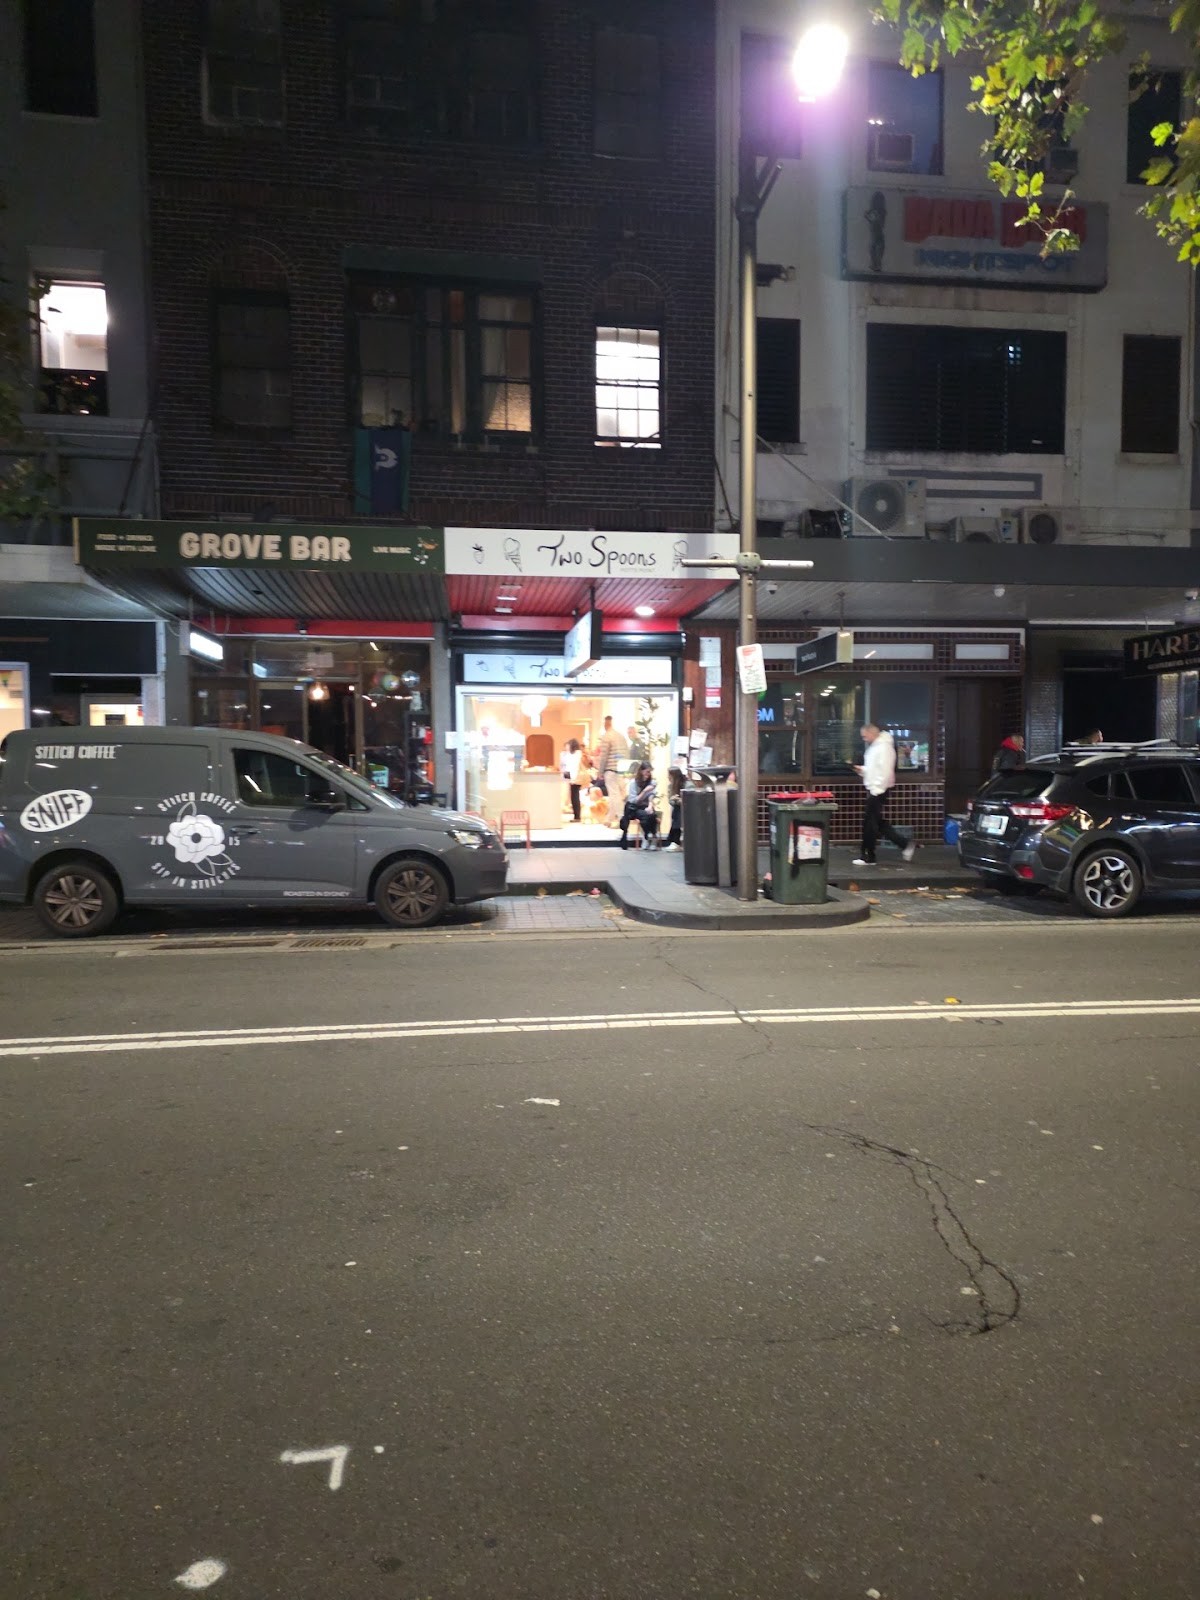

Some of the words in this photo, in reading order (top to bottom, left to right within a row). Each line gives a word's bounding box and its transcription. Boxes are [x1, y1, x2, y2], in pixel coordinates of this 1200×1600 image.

[180, 532, 282, 560] GROVE
[290, 535, 352, 562] BAR
[35, 746, 75, 759] STITCH
[78, 746, 116, 759] COFFEE
[27, 793, 84, 828] SNIFF
[157, 792, 196, 812] STITCH
[201, 792, 237, 814] COFFEE
[151, 862, 171, 878] SIP
